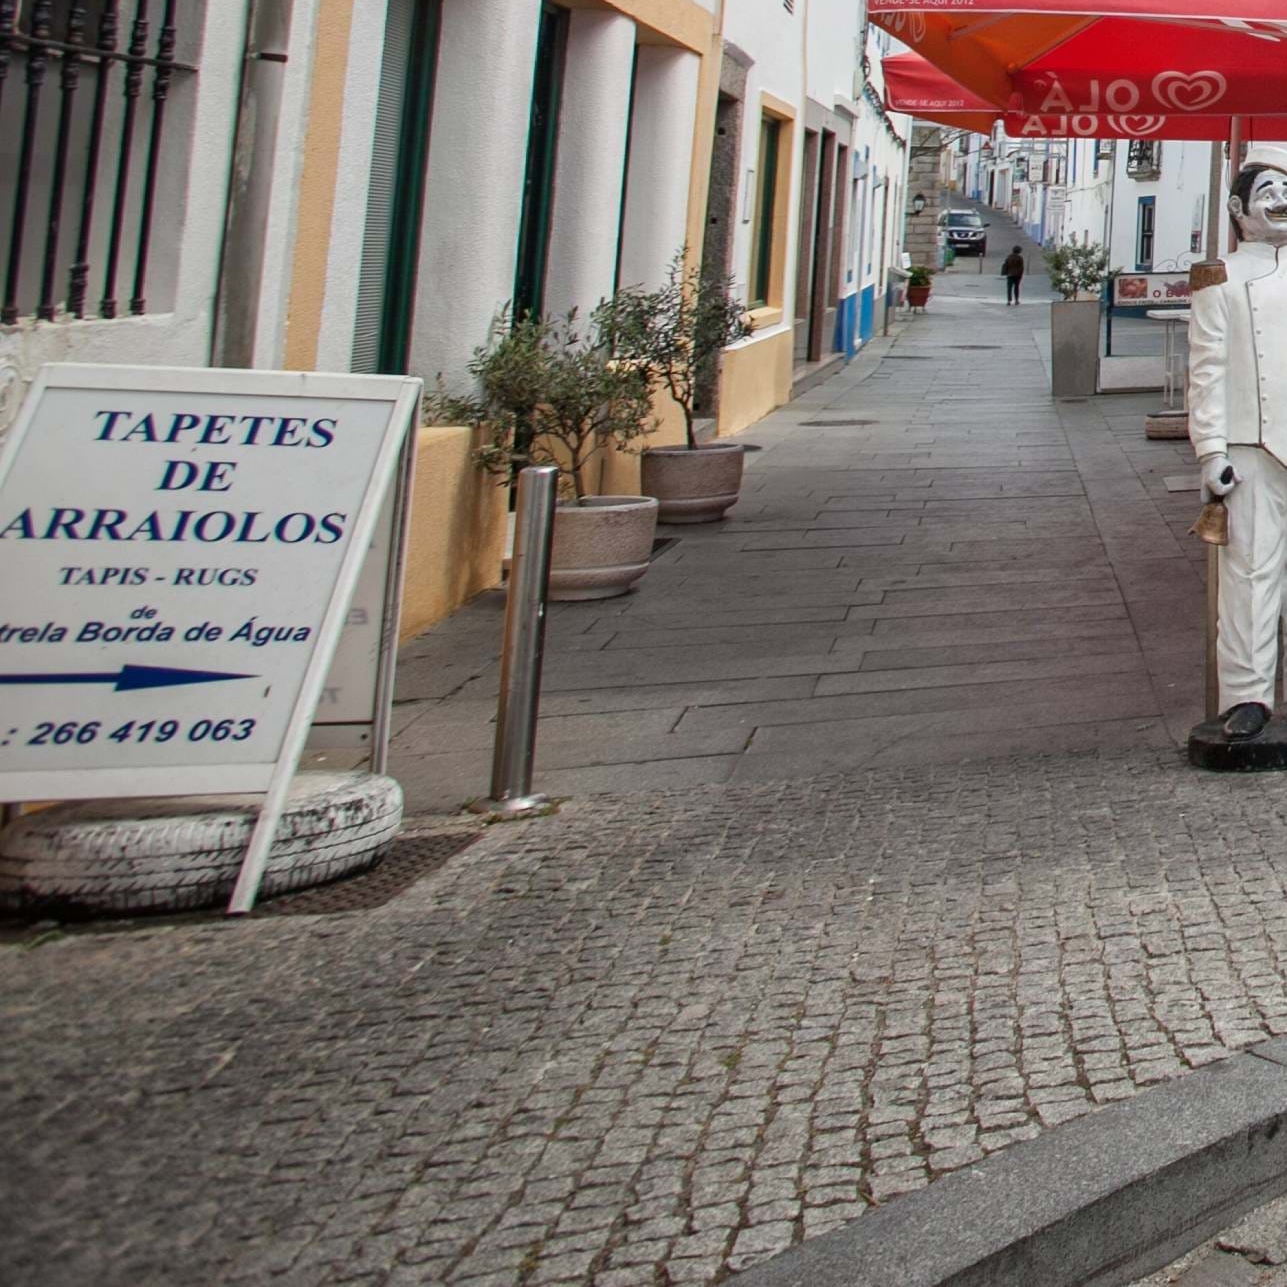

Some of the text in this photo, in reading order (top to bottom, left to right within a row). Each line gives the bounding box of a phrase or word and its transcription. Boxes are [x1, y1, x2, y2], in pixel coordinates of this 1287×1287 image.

[895, 99, 927, 107] VENDE-SE
[928, 100, 947, 108] AQUI
[93, 410, 338, 448] TAPETES
[155, 460, 239, 492] DE
[0, 507, 348, 544] ARRAIOLOS
[59, 567, 149, 586] TAPIS
[172, 567, 259, 587] RUGS
[130, 605, 158, 620] de
[76, 621, 176, 644] Borda
[184, 621, 224, 643] de
[228, 616, 313, 647] Água
[26, 719, 257, 747] 266 419 063
